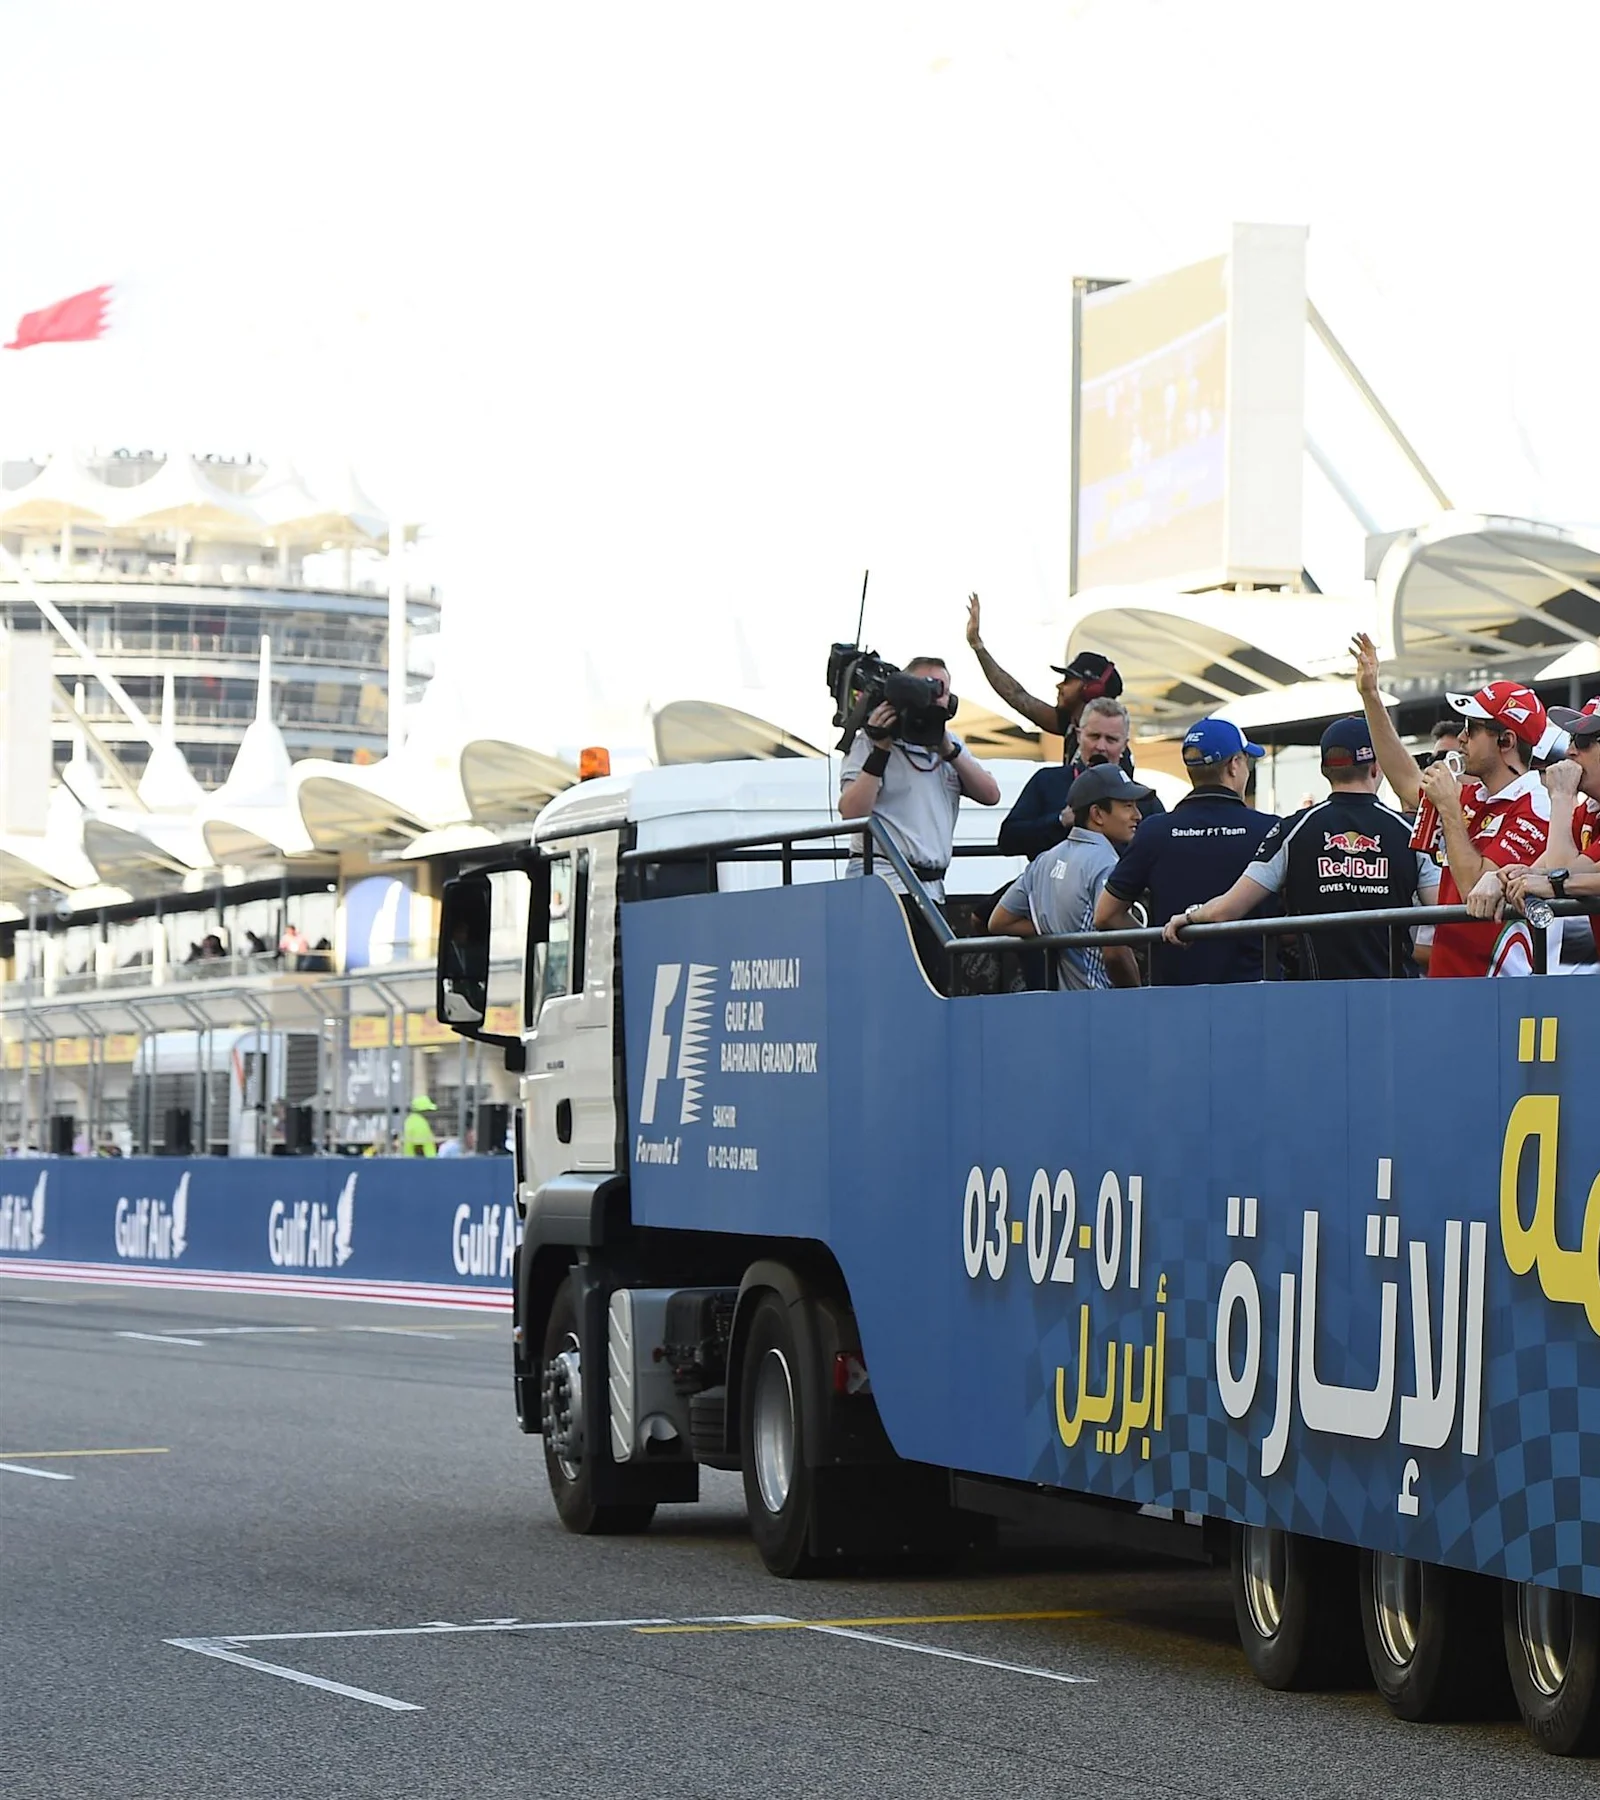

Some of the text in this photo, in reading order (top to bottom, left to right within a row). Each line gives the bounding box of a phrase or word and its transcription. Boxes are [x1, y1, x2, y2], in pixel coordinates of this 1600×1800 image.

[1455, 698, 1471, 707] 5
[1171, 826, 1247, 838] Sauber F1 Team
[1319, 883, 1344, 893] GIVES
[1359, 885, 1389, 894] WINGS
[730, 957, 801, 990] 2016 FORMULA 1
[725, 1001, 764, 1032] GULF AIR
[721, 1042, 818, 1074] BAHRAIN GRAND PRIX
[635, 1134, 673, 1164] Formula
[707, 1145, 758, 1171] 01-02-03 APRIL
[115, 1197, 172, 1259] Gulf Air
[269, 1200, 336, 1267] Gulf Air
[453, 1203, 500, 1276] Gulf
[1214, 1157, 1488, 1517] الإثارة
[1054, 1272, 1168, 1461] أبريل
